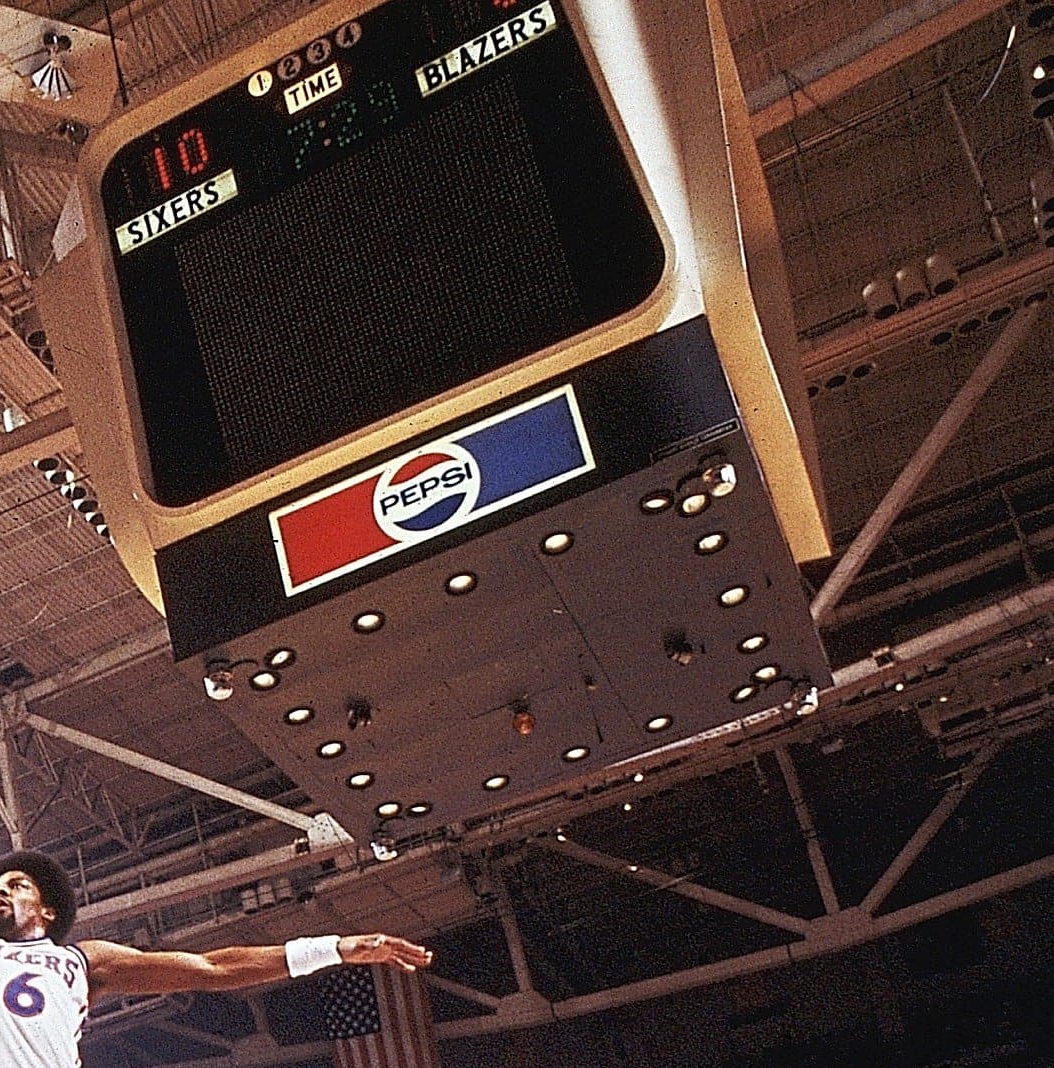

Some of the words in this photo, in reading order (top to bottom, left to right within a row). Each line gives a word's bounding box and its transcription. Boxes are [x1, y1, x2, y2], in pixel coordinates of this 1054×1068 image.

[282, 57, 297, 77] 2
[312, 41, 326, 60] 3
[342, 23, 355, 44] 4
[422, 7, 547, 91] BLAZERS
[288, 68, 339, 107] TIME
[153, 129, 211, 190] 10
[126, 180, 222, 245] SIXERS
[378, 461, 473, 518] PEPSI
[3, 971, 46, 1018] 6
